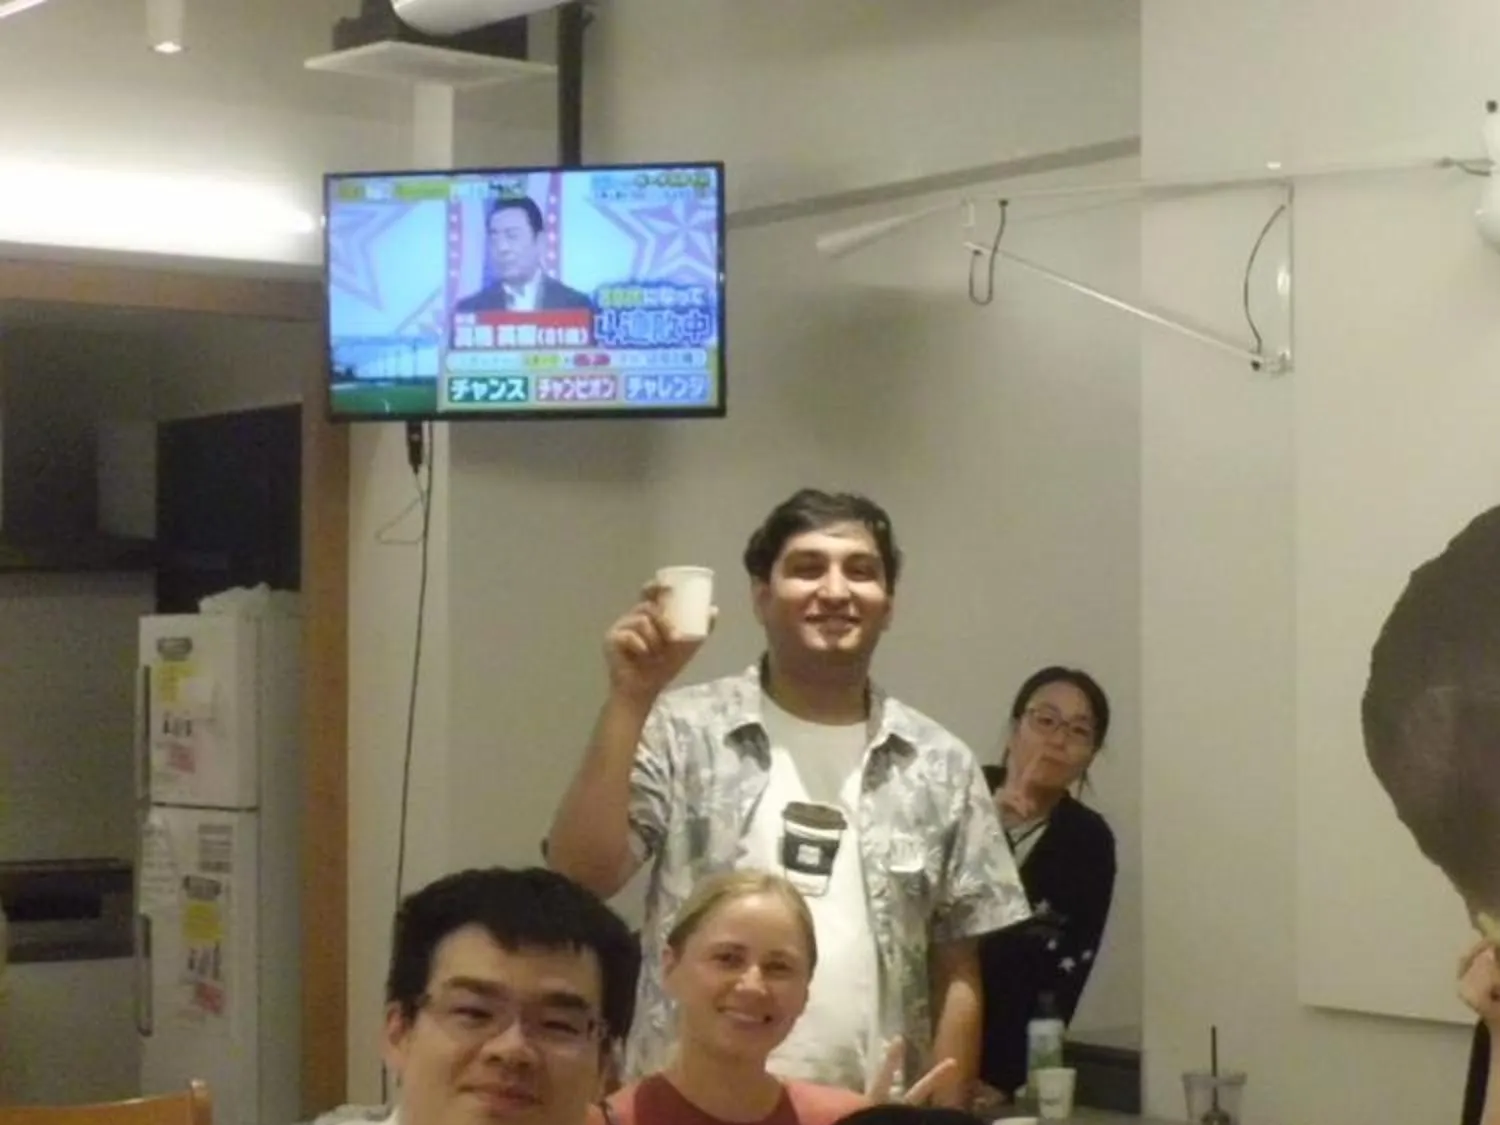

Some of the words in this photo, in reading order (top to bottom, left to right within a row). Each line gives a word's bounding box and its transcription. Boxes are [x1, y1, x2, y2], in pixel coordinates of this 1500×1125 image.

[450, 377, 527, 400] チャンス
[537, 378, 617, 400] チャンピオン
[626, 376, 705, 399] チャレンジ
